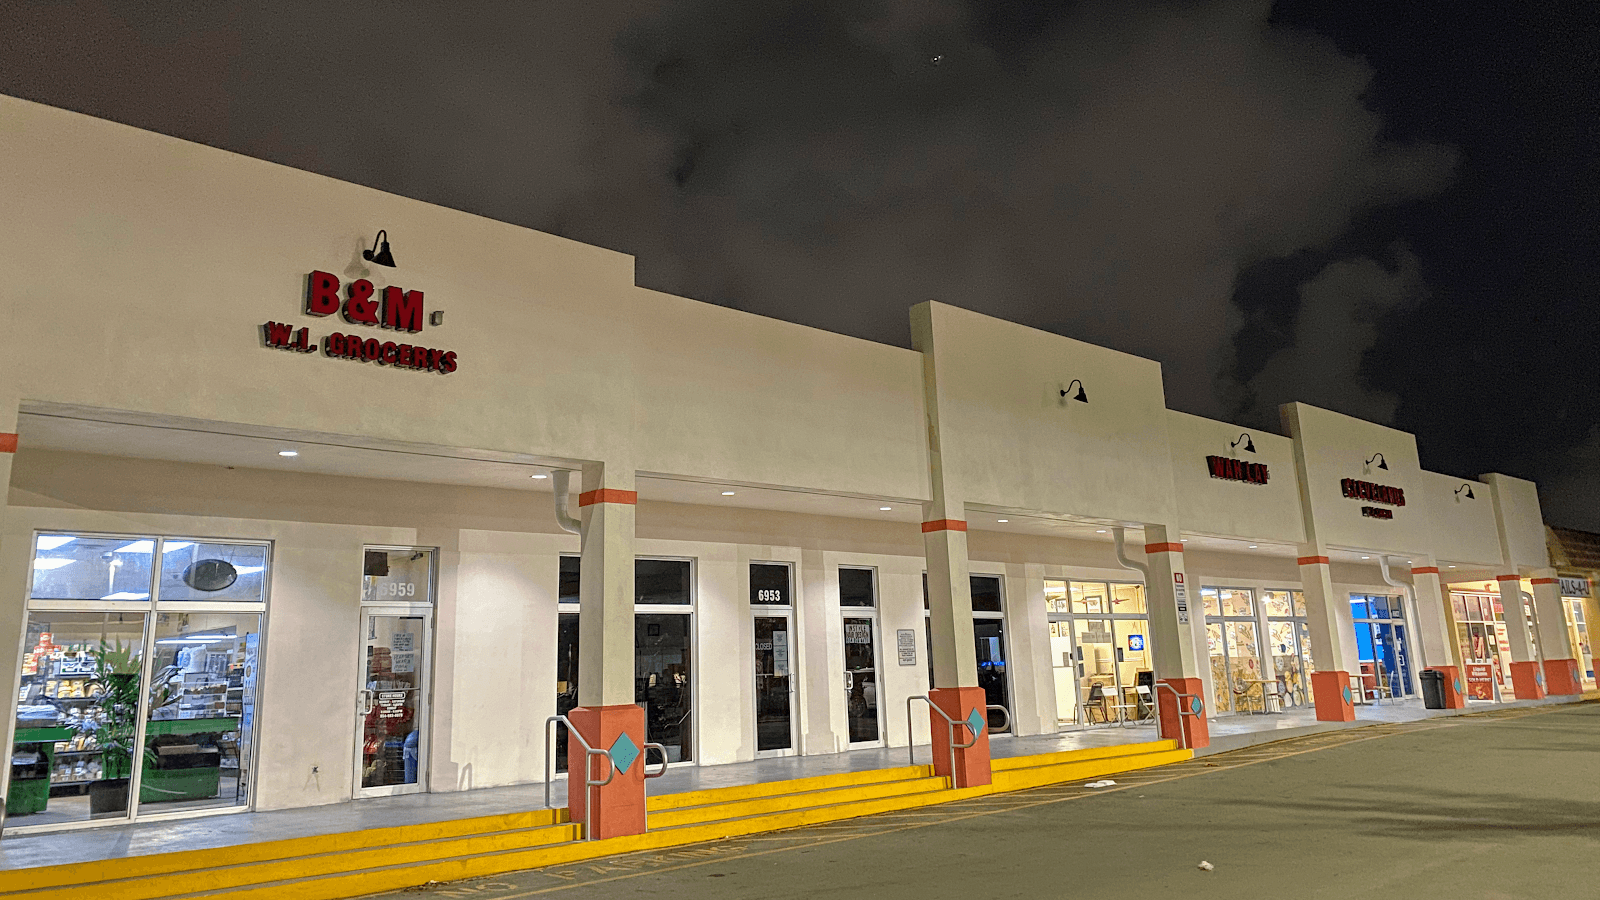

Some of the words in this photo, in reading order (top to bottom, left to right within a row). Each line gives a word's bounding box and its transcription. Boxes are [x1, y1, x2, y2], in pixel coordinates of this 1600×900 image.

[306, 270, 424, 332] B&M
[266, 321, 317, 352] W.I.
[326, 332, 458, 373] GROCERYS
[380, 583, 415, 597] 6959
[758, 590, 781, 602] 6953
